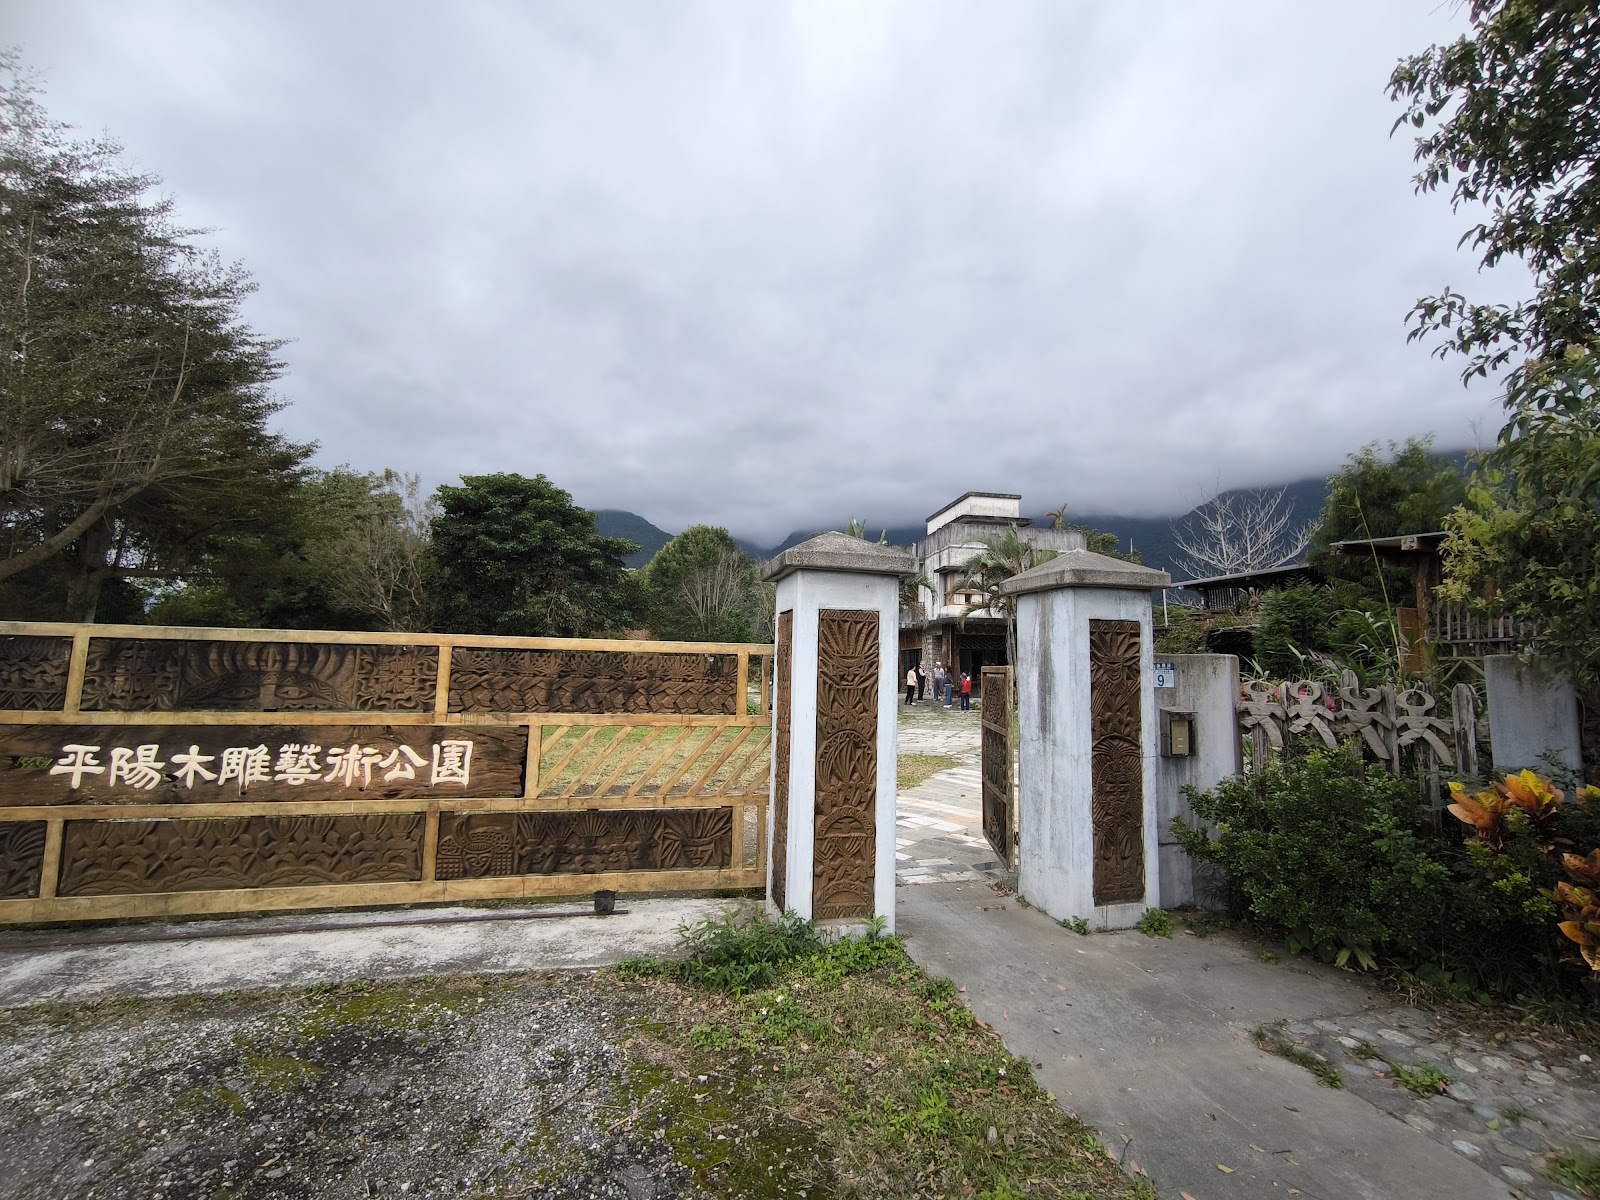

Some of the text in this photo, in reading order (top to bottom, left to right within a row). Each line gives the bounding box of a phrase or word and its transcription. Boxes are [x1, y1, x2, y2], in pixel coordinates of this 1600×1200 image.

[1157, 674, 1165, 687] 9
[49, 740, 474, 792] 平陽木雕藝術公園
